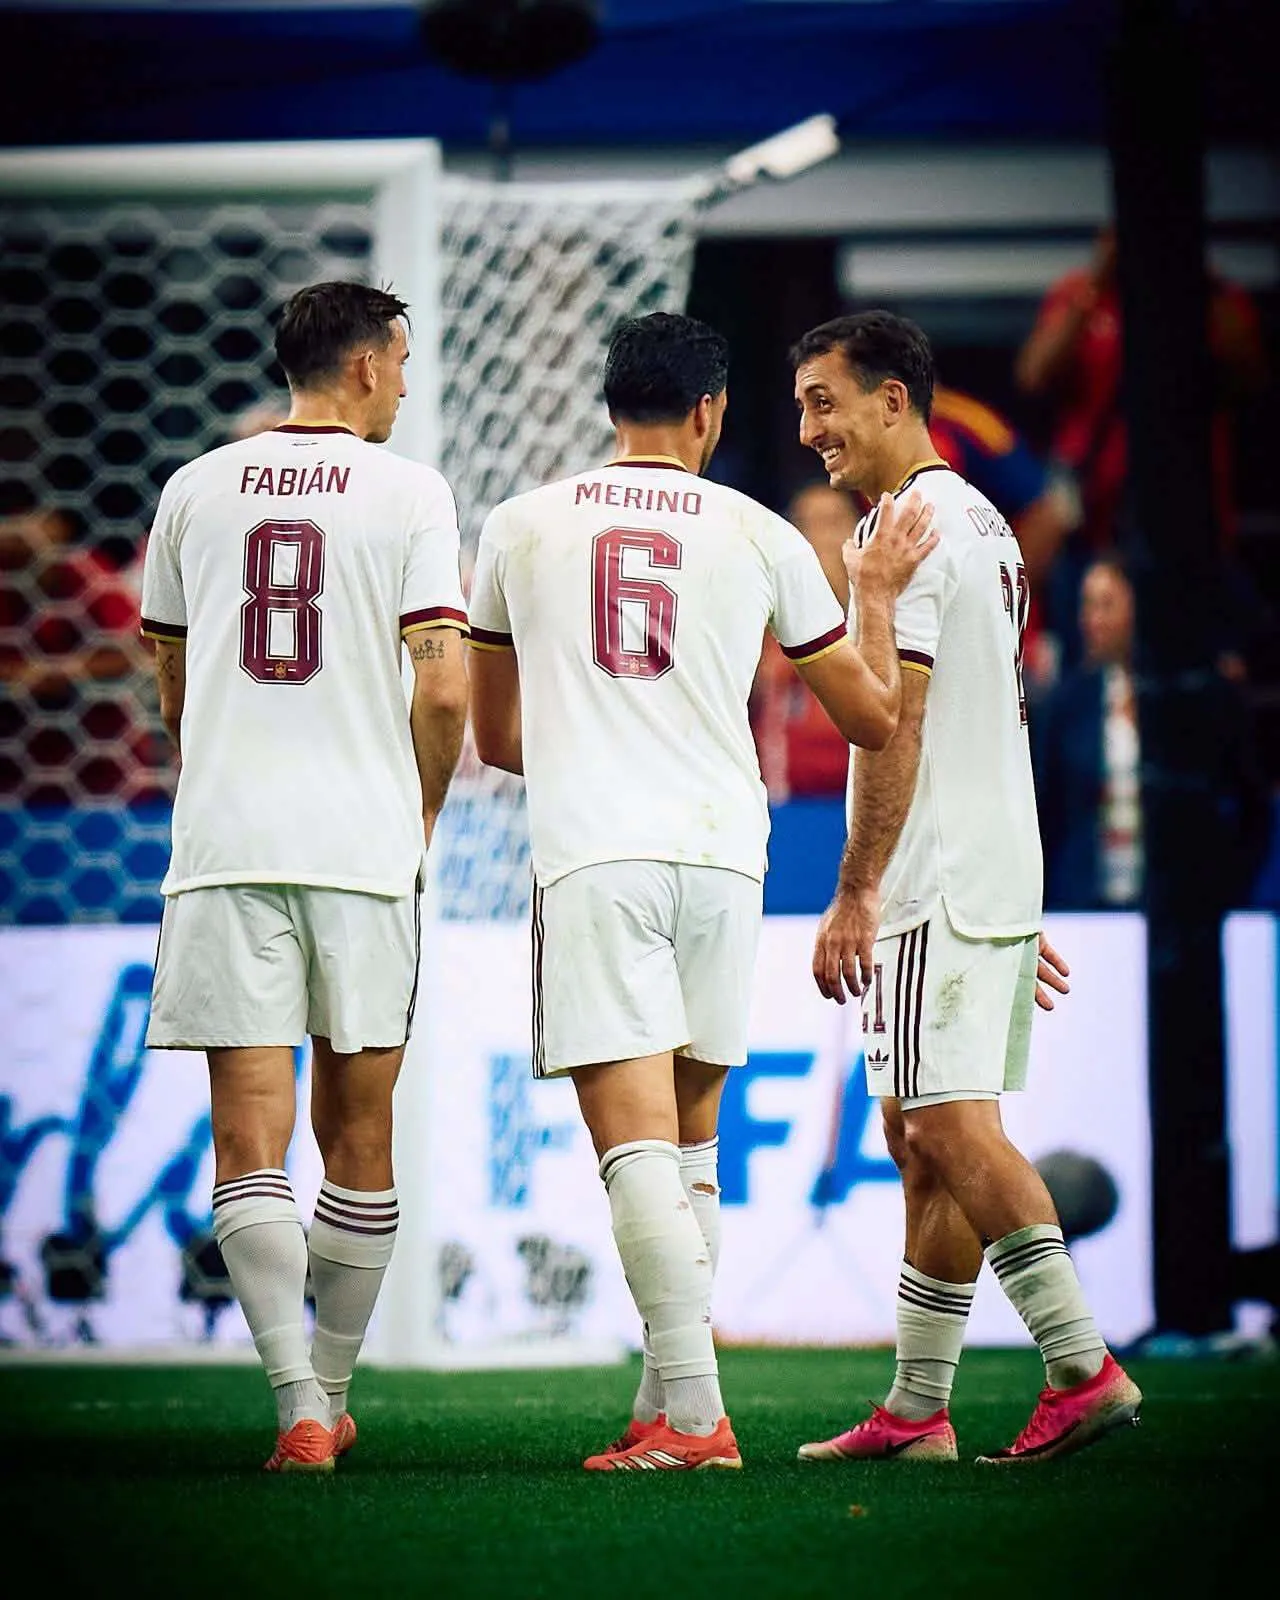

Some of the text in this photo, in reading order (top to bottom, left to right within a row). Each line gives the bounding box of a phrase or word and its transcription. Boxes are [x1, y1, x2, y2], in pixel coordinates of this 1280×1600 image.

[240, 460, 351, 496] FABIÁN
[575, 482, 702, 516] MERINO
[239, 518, 327, 686] 8
[590, 525, 683, 681] 6
